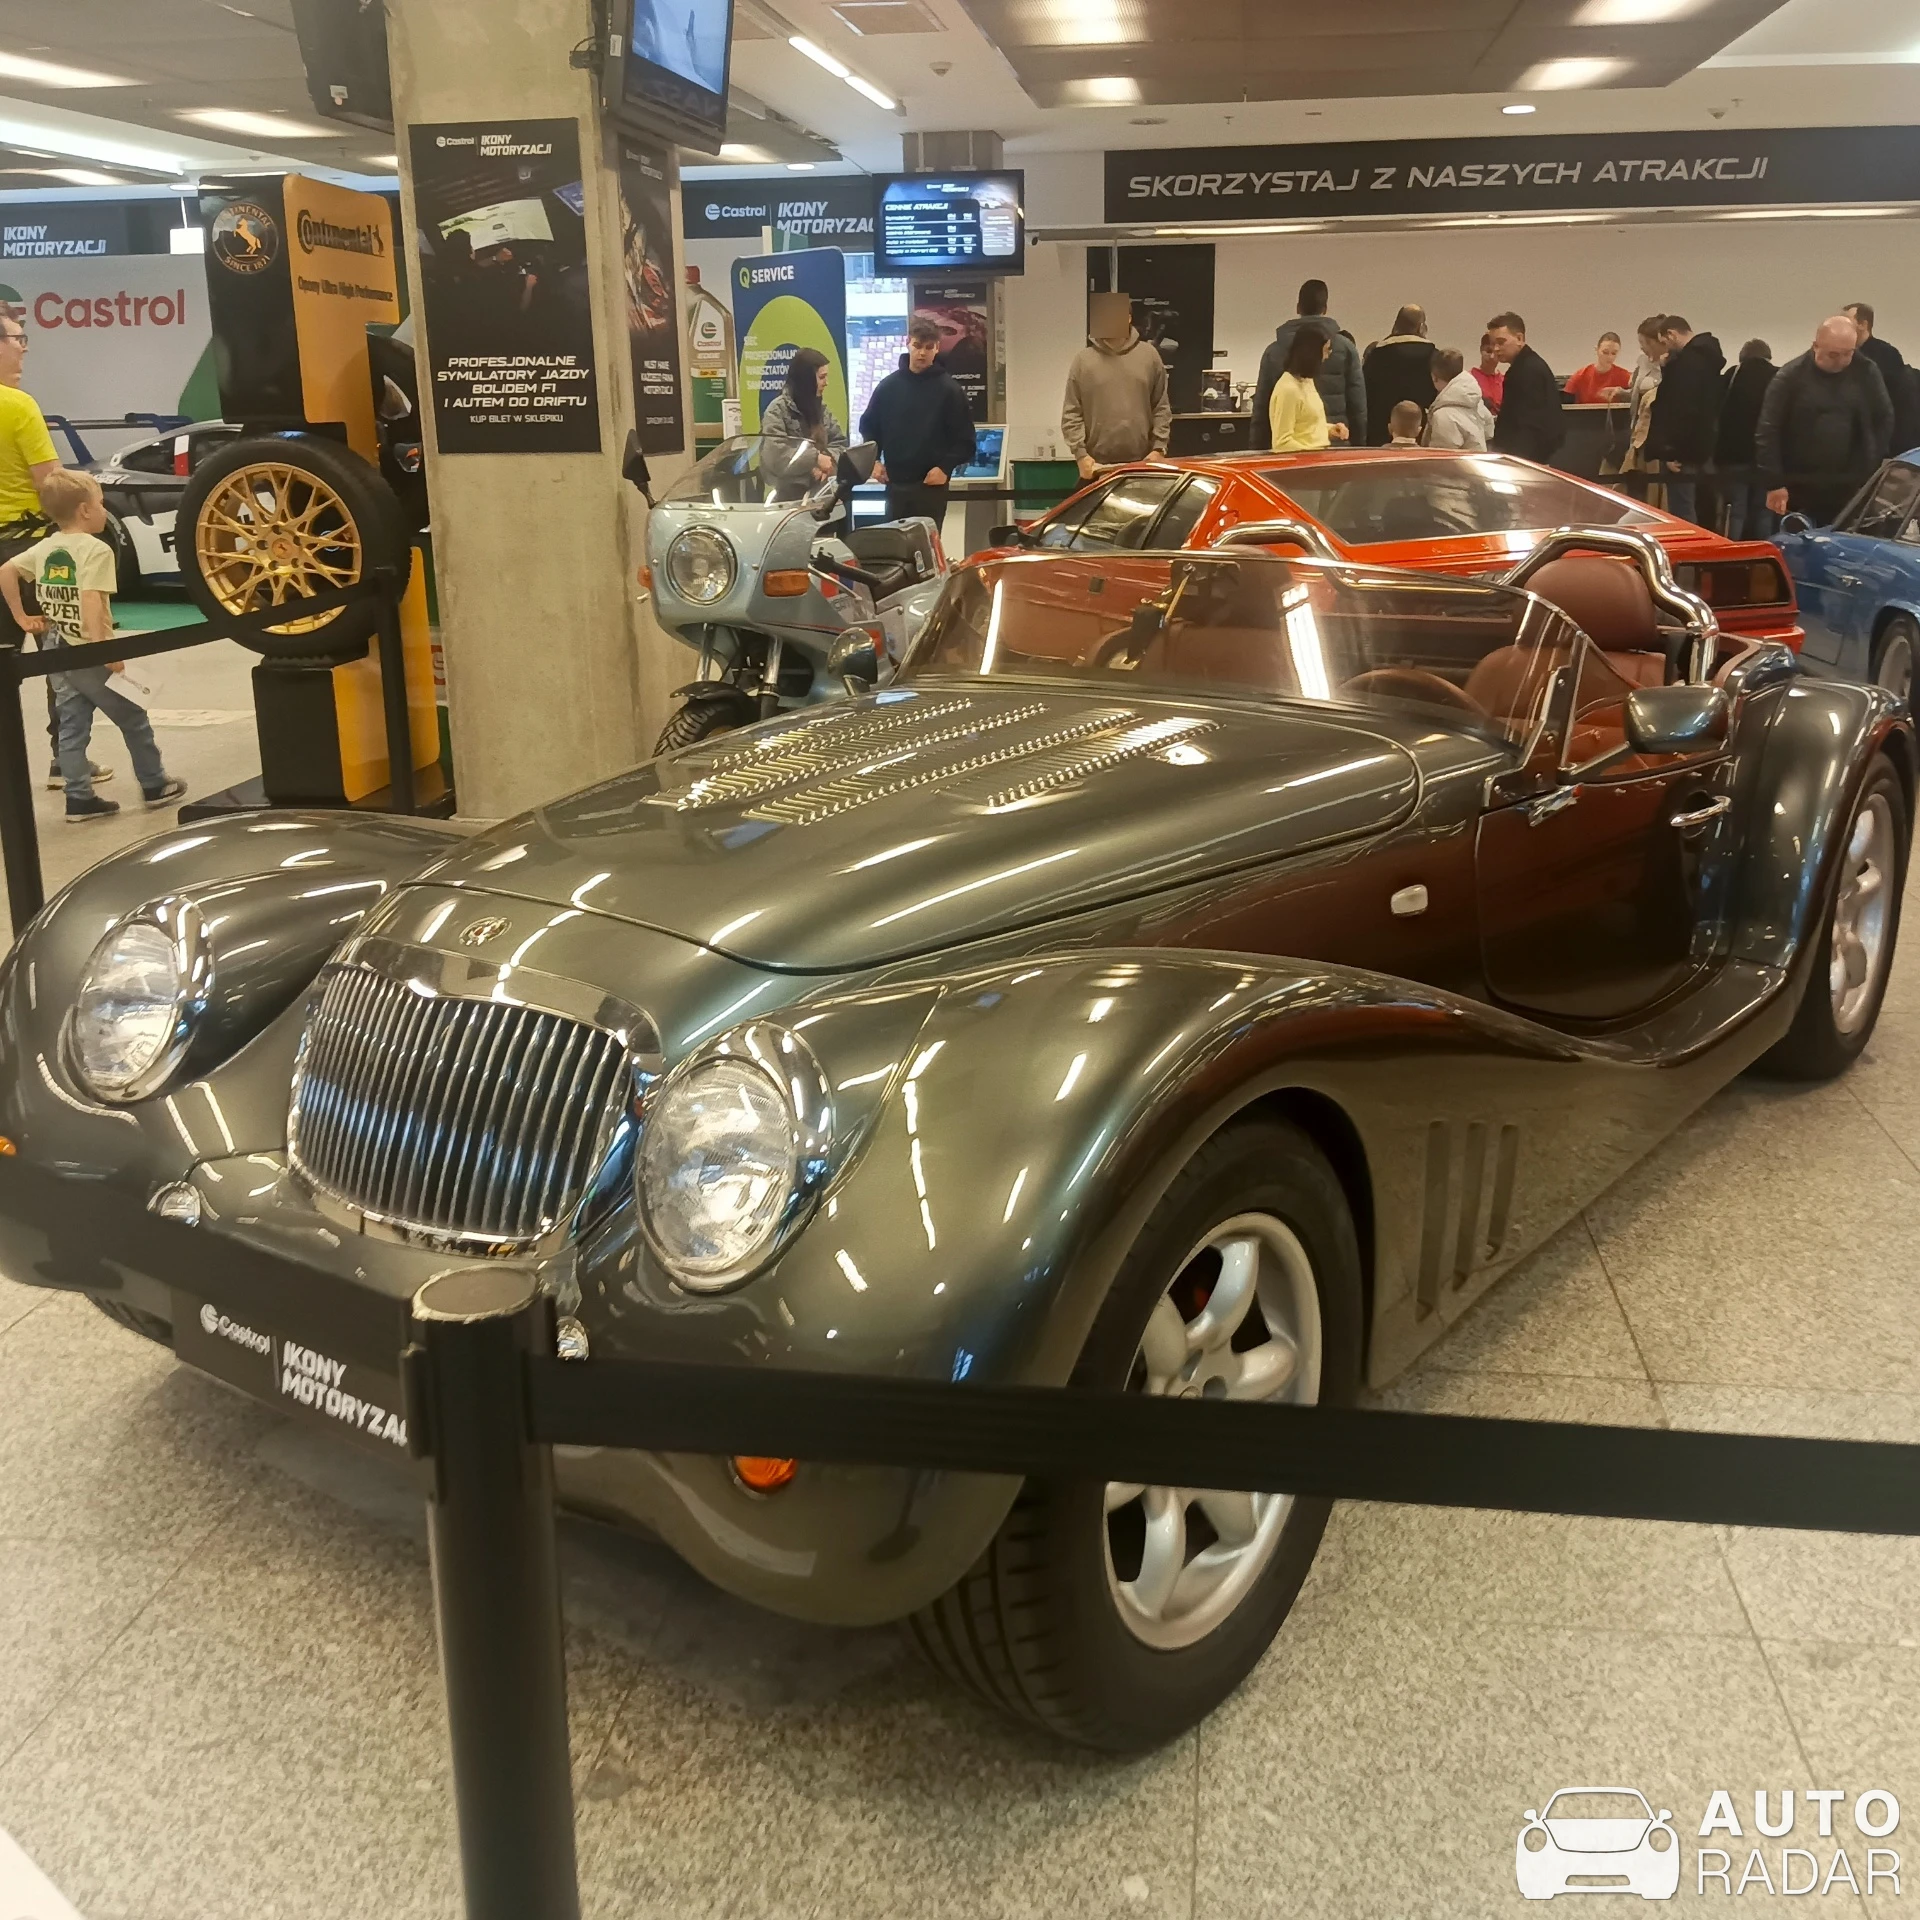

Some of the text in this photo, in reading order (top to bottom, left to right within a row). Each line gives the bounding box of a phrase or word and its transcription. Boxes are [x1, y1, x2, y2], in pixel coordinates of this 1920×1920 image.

[446, 137, 475, 146] Castrol
[481, 134, 512, 146] IKONY
[480, 144, 552, 156] MOTORYZACJI
[1127, 157, 1769, 198] SKORZYSTAJ Z NASZYCH ATRAKCJI
[722, 205, 766, 218] Castrol
[777, 201, 828, 218] IKONY
[3, 225, 47, 240] IKONY
[3, 239, 107, 257] MOTORYZACJI
[224, 254, 271, 272] SINCE 1871
[751, 265, 795, 284] SERVICE
[34, 288, 186, 329] Castrol
[448, 355, 577, 368] PROFESJONALNE
[437, 369, 590, 382] SYMULATORY JAZDY
[472, 383, 557, 395] BOLIDEM F1
[443, 396, 587, 408] I AUTEM DO DRIFTU
[470, 414, 564, 424] KUP BILET W SKLEPIKU
[45, 585, 80, 603] NINJA
[41, 600, 81, 621] EVER
[218, 1315, 271, 1356] Castrol
[282, 1340, 347, 1388] IKONY
